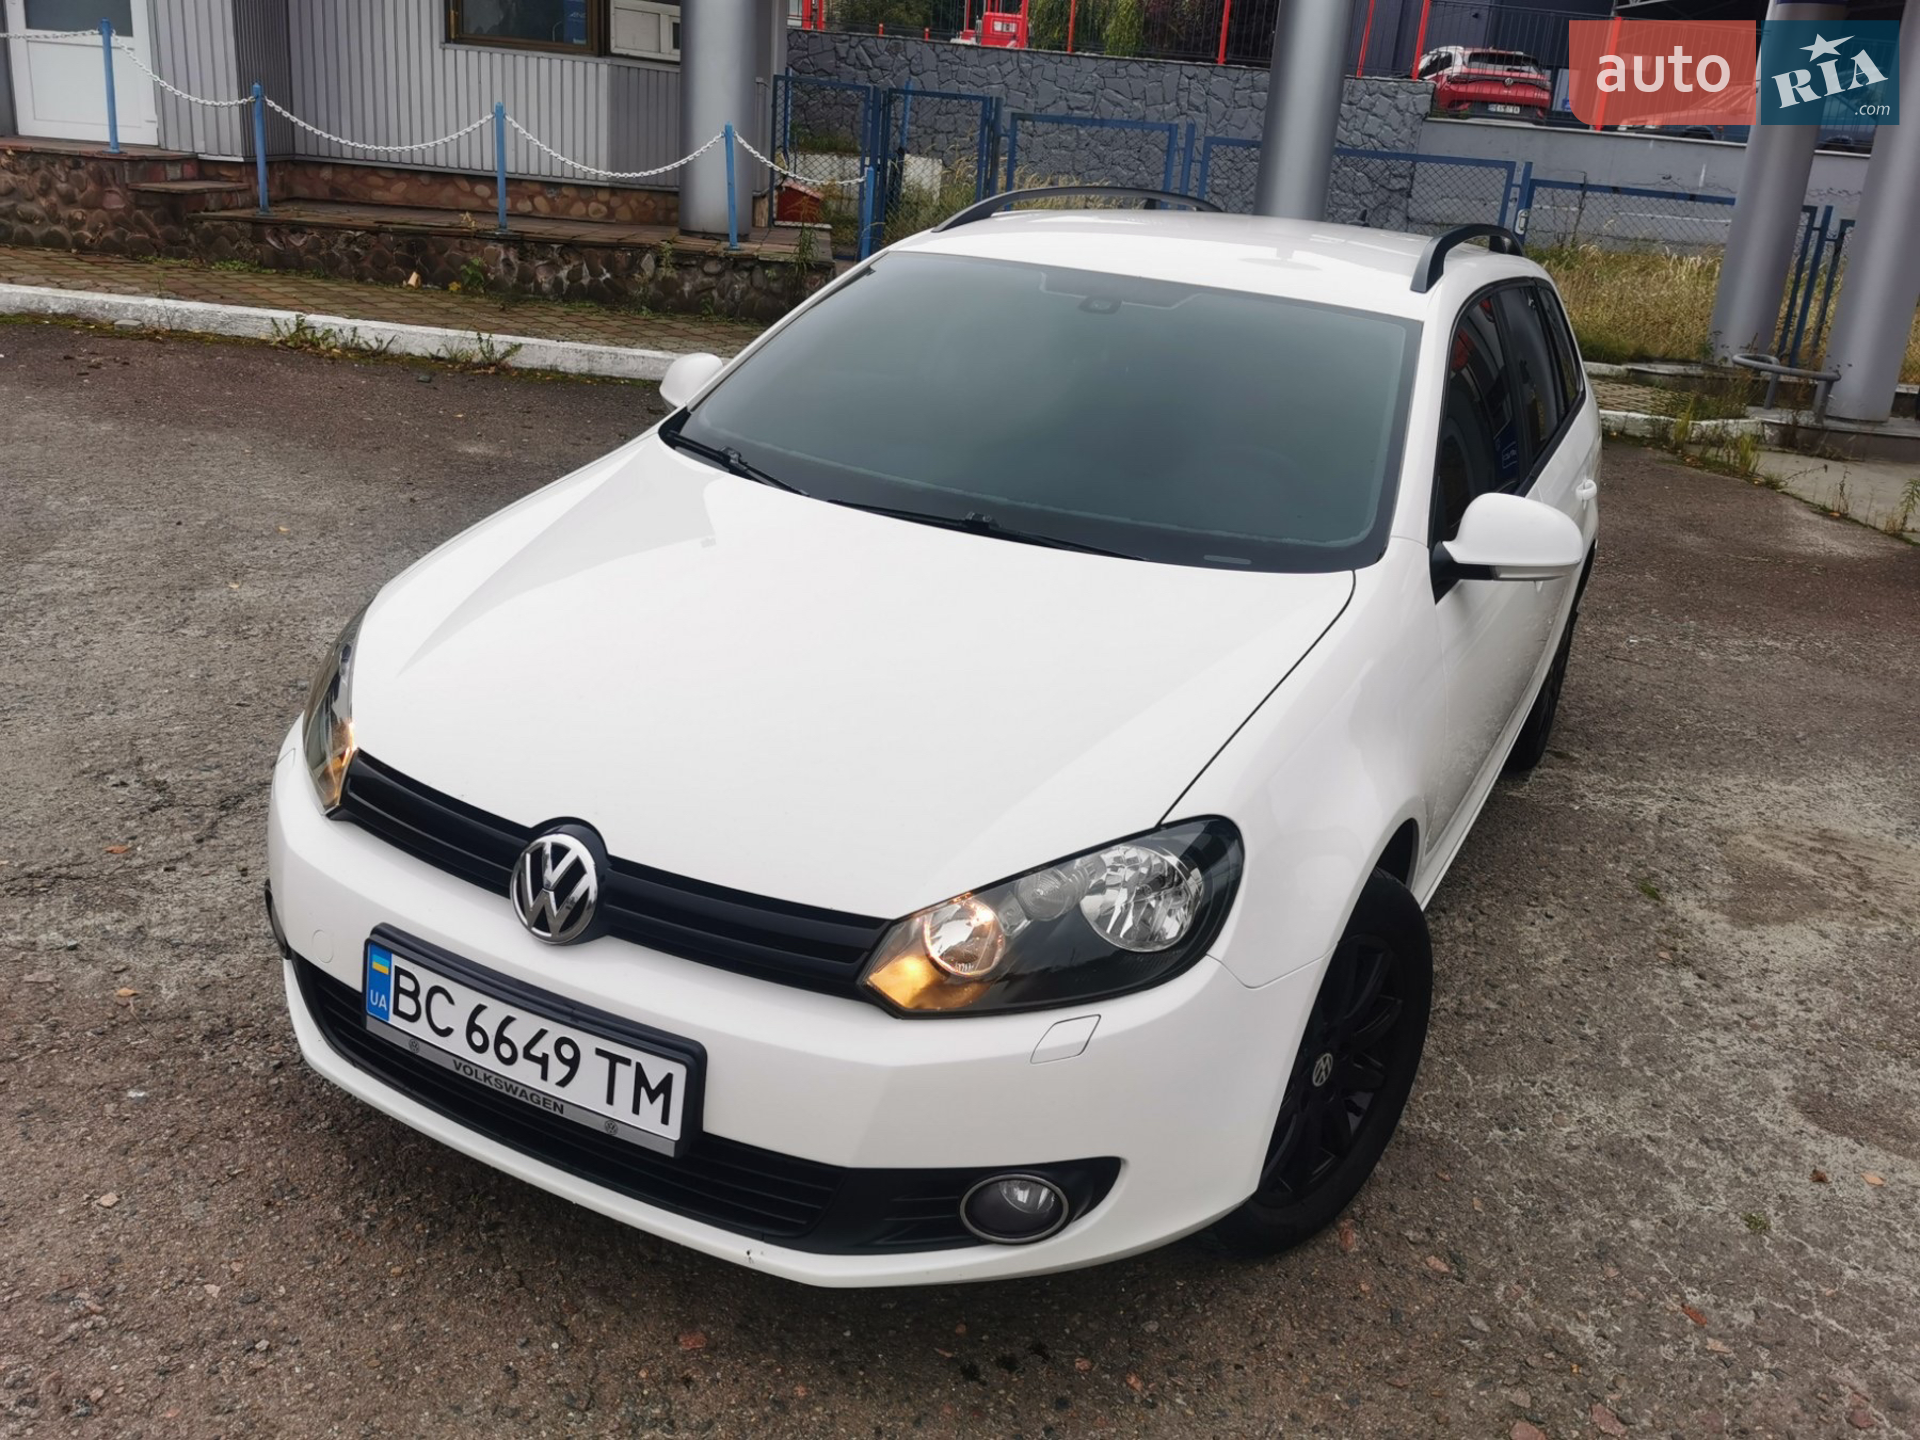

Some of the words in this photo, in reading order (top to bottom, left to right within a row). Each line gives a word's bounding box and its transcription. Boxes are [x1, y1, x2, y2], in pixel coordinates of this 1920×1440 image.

[370, 989, 388, 1011] UA
[392, 965, 456, 1038] BC
[465, 1003, 581, 1088] 6649
[594, 1047, 674, 1126] TM
[452, 1059, 564, 1115] VOLKSWAGEN
